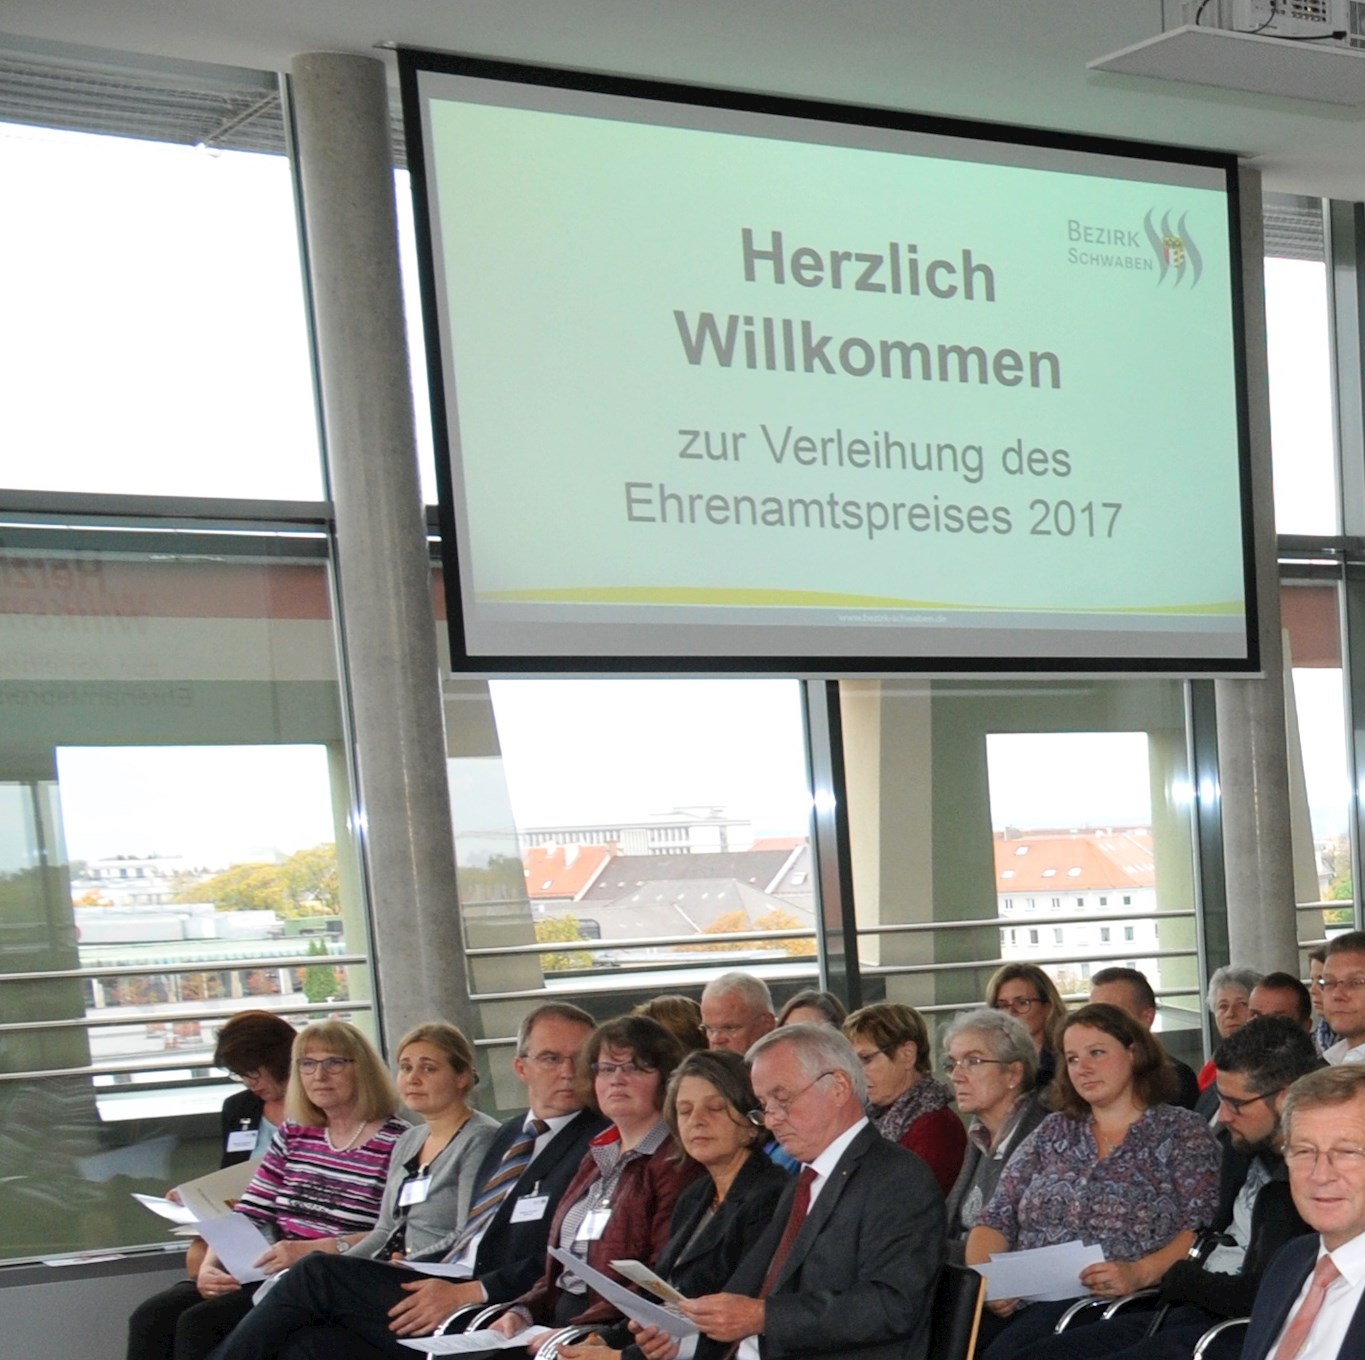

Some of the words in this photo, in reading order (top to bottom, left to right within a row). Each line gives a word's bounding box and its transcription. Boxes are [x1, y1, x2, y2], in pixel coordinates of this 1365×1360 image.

[1067, 219, 1141, 248] BEZIRK
[1067, 247, 1154, 271] SCHWABEN
[741, 226, 997, 303] Herzlich
[673, 310, 1062, 389] Willkommen
[678, 427, 747, 462] zur
[760, 424, 985, 483] Verleihung
[1003, 437, 1073, 477] des
[625, 481, 1013, 541] Ehrenamtspreises
[1029, 498, 1123, 540] 2017
